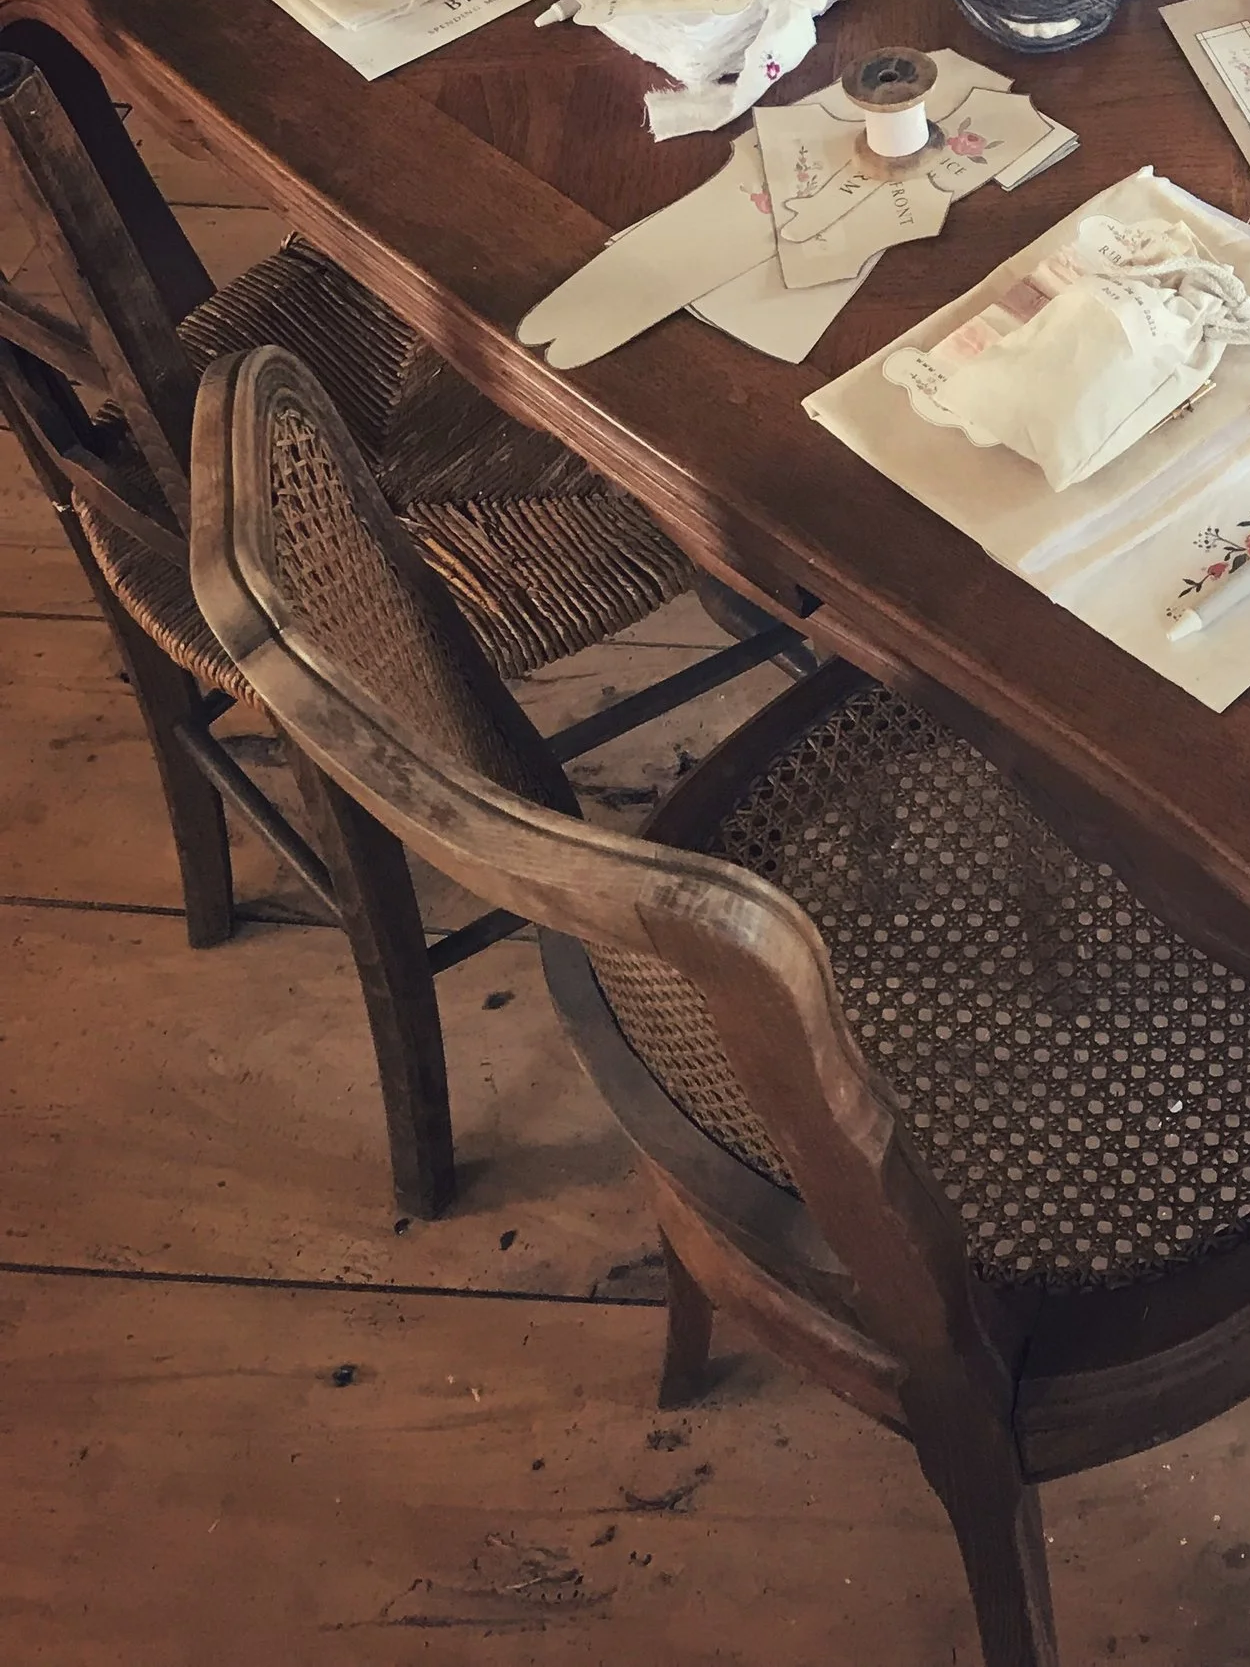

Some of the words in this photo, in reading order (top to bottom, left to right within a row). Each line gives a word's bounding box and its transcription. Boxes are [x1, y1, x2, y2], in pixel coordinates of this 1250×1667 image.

[427, 4, 481, 36] SPENDING
[939, 157, 967, 176] ICE
[889, 181, 914, 226] FRONT
